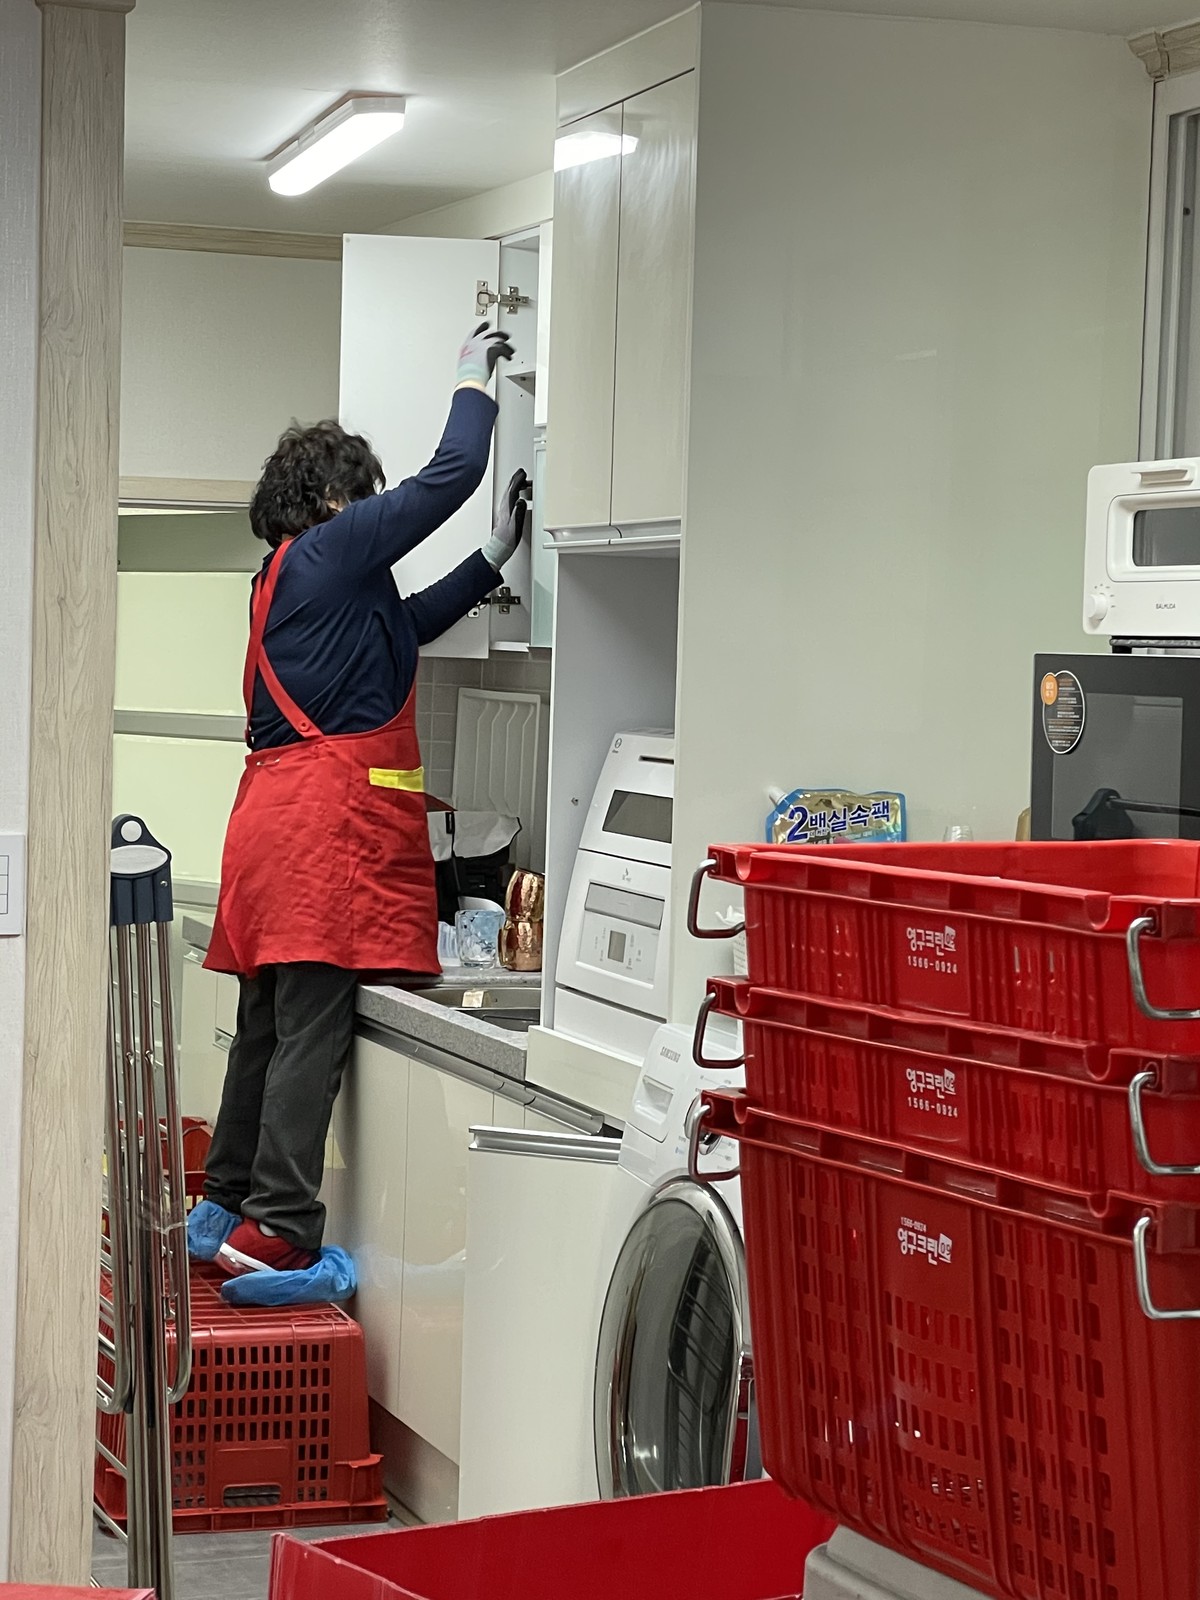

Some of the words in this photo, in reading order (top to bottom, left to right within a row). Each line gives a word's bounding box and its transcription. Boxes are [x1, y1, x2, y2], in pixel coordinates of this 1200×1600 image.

[906, 927, 945, 956] 영구크린
[908, 955, 958, 974] 1566-0924
[659, 1046, 681, 1063] SAMSUNG
[906, 1068, 945, 1100] 영구크린
[908, 1097, 959, 1118] 1566-0924
[897, 1227, 938, 1266] 영구크린
